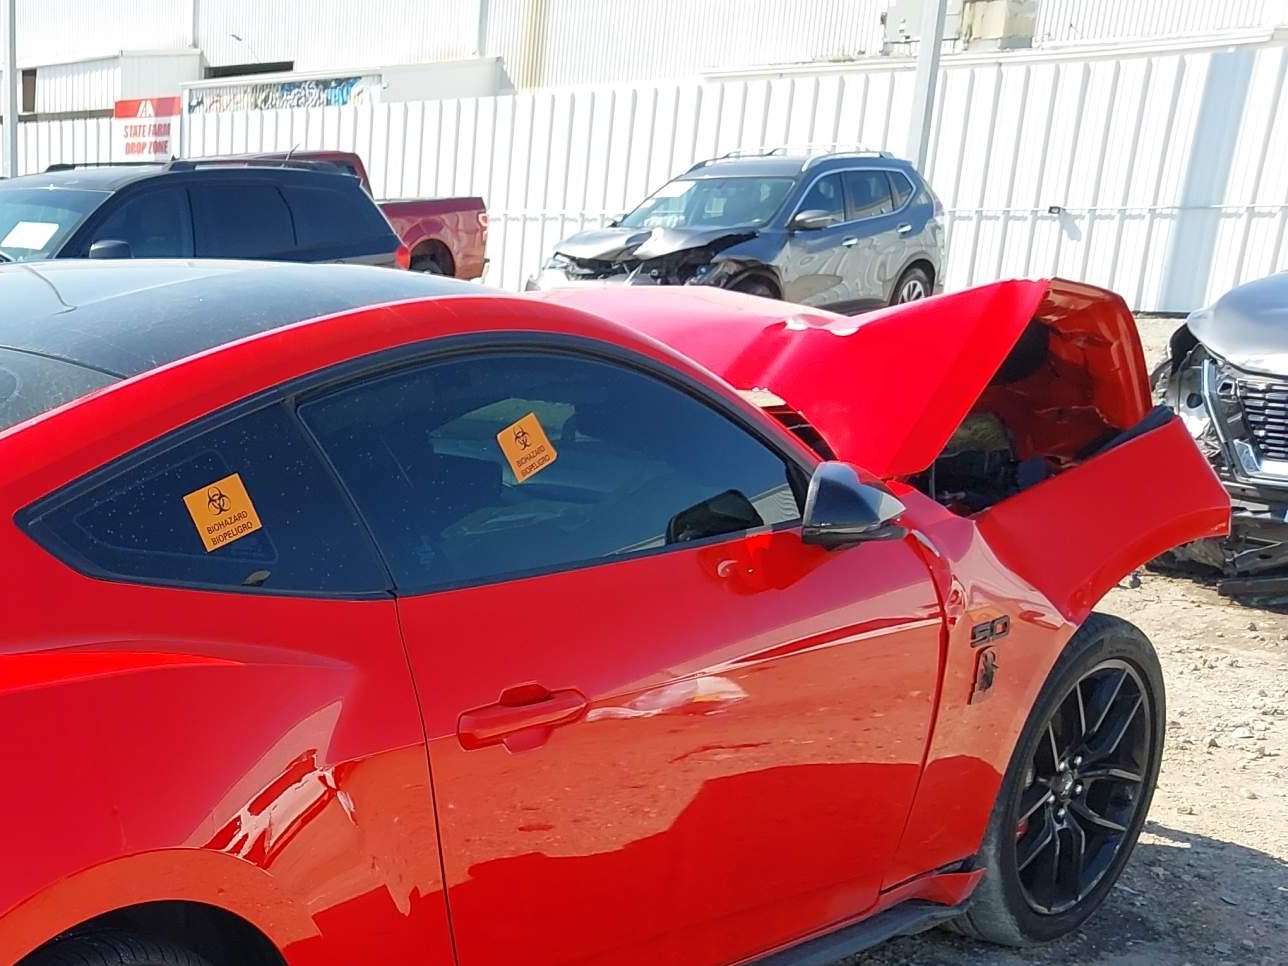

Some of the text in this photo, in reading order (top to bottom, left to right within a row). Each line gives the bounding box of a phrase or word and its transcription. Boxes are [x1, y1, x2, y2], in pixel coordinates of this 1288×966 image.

[124, 123, 171, 138] STATE FARM
[125, 140, 169, 155] DROP ZONE
[206, 510, 248, 535] BIOHAZARD
[210, 521, 253, 546] BIOPELIGRO
